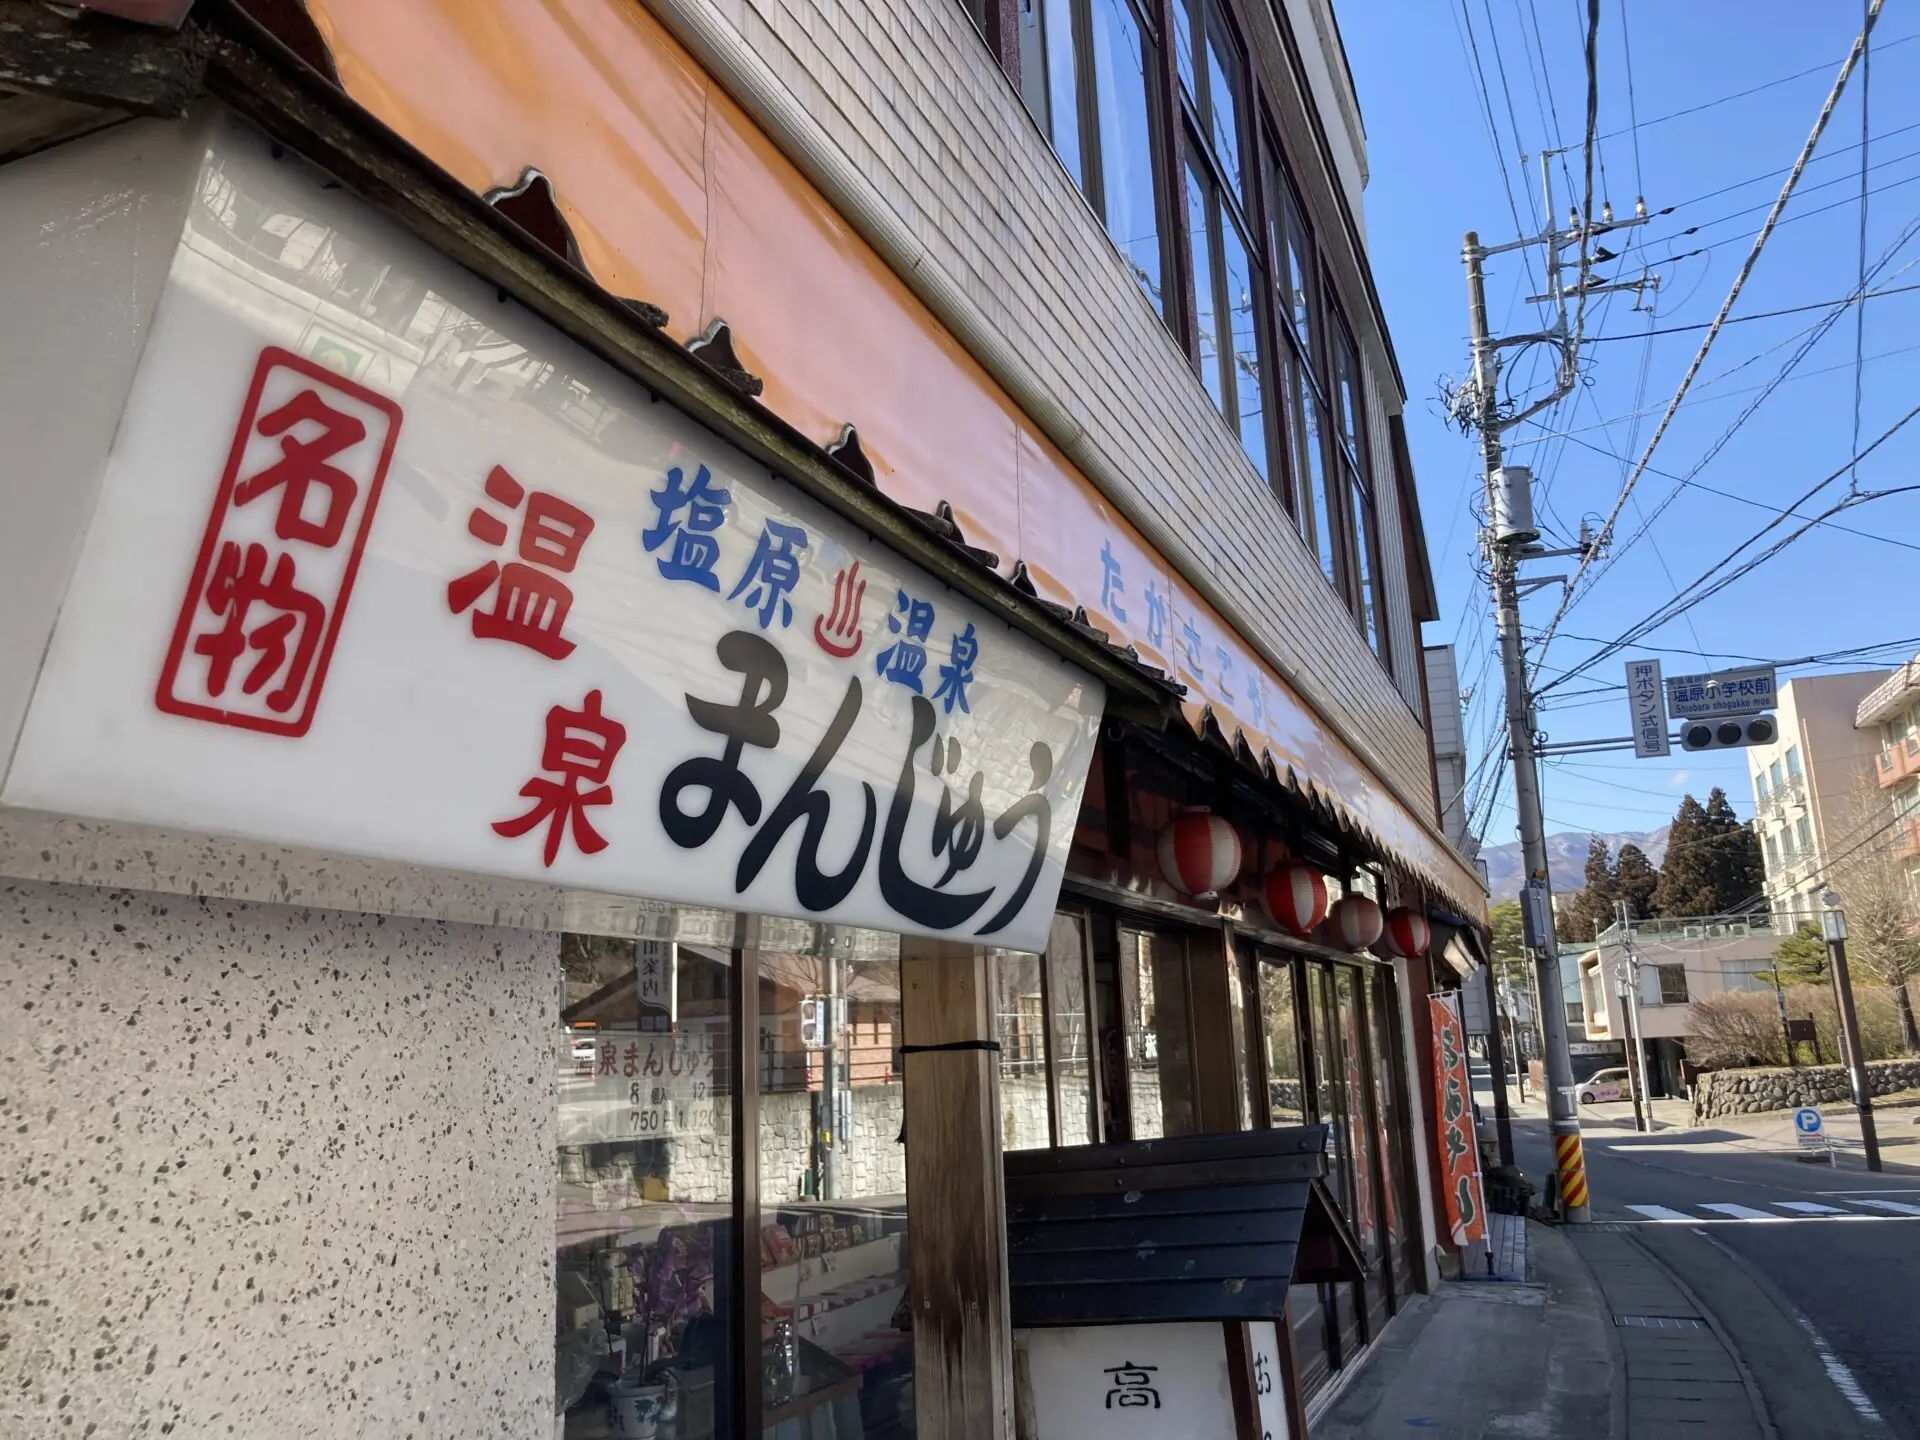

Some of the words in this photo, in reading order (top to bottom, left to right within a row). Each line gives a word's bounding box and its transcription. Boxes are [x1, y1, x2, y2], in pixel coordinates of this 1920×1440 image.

[194, 388, 367, 715] 名物
[642, 463, 808, 629] 塩原
[876, 586, 980, 714] 温泉
[447, 464, 627, 868] 温泉
[1634, 665, 1660, 753] 押ボタン式信号
[1673, 677, 1771, 704] 塩原小学校前
[1675, 702, 1710, 714] Shiobara
[1713, 699, 1750, 712] shogakko
[658, 628, 1054, 936] まんじゅう
[1103, 1360, 1161, 1410] 高
